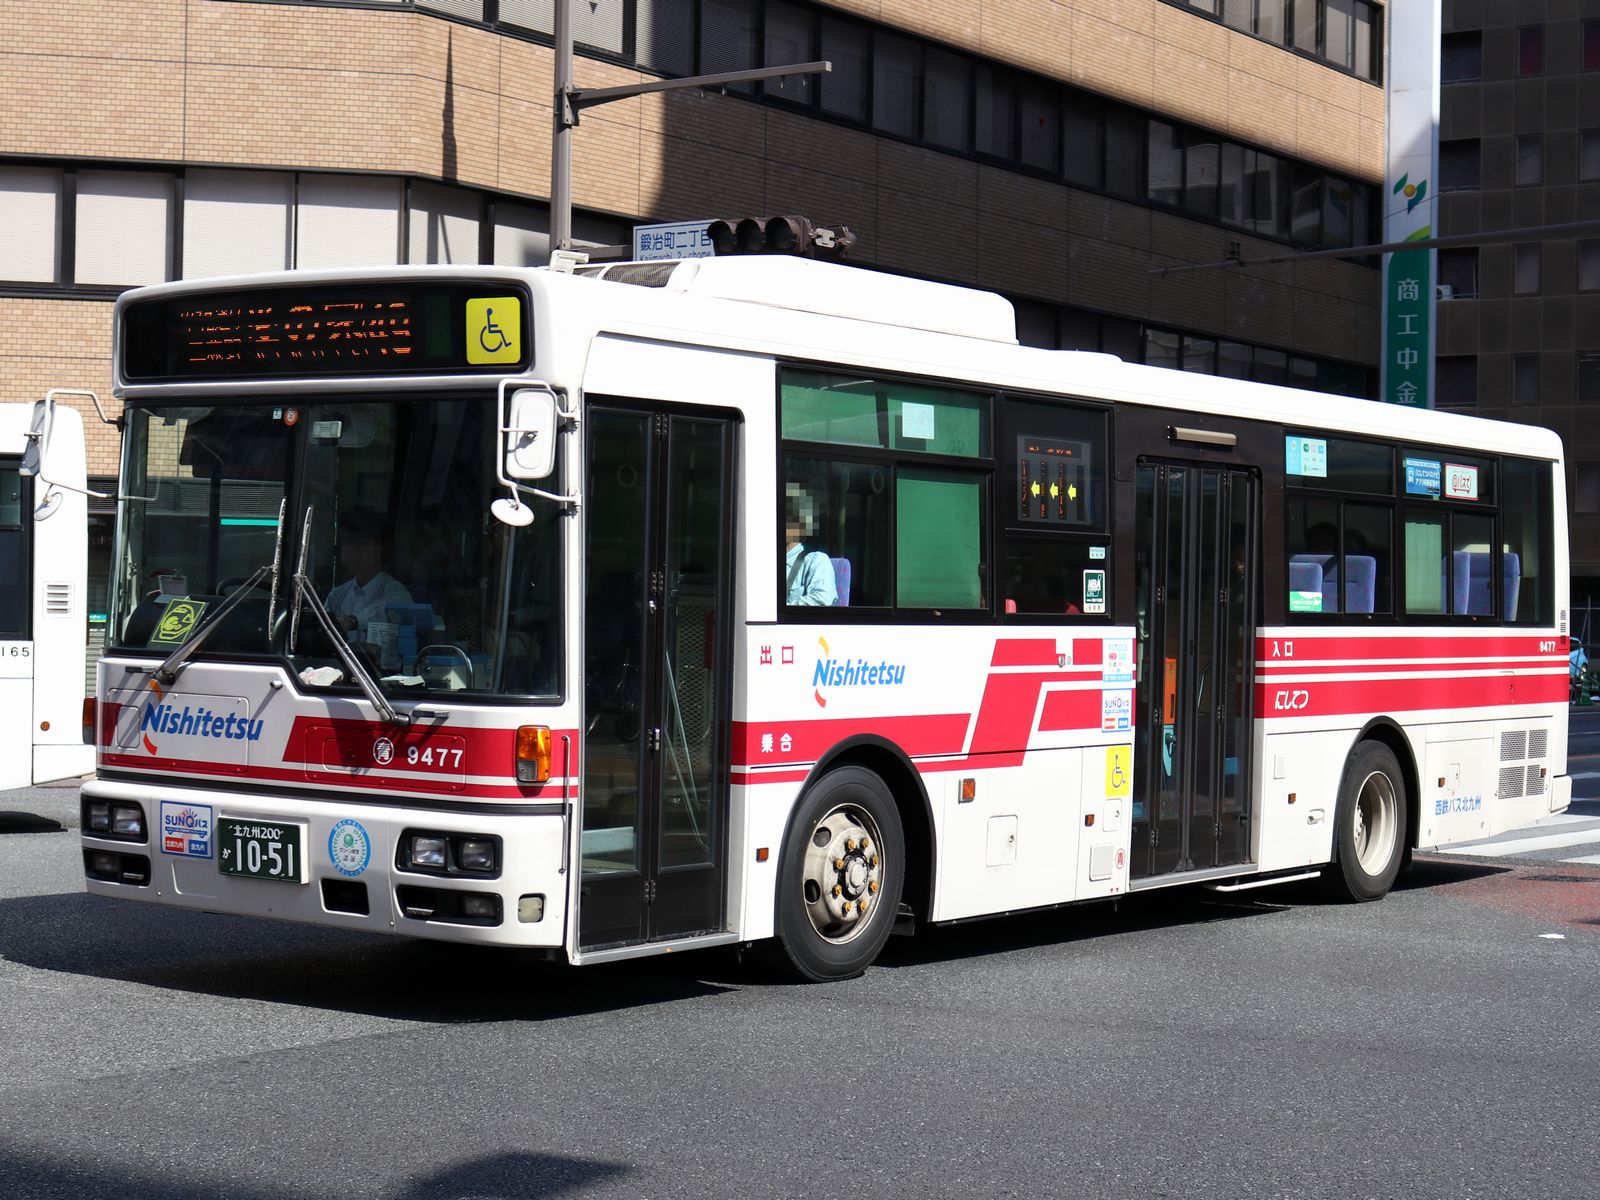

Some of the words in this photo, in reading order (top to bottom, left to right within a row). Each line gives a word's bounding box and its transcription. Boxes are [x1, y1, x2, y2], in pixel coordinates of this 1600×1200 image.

[1396, 278, 1419, 404] 商工中金
[760, 645, 794, 665] 出口
[1272, 640, 1294, 657] 入口
[1539, 640, 1556, 652] 9477
[812, 658, 905, 687] Nishitetsu
[1275, 690, 1310, 710] にしてつ
[141, 702, 264, 741] Nishitetsu
[760, 733, 793, 753] 乗合
[408, 745, 463, 768] 9477
[1435, 795, 1481, 815] 西鉄バス北九州
[233, 825, 281, 840] 北九州200
[236, 838, 293, 877] 10-51
